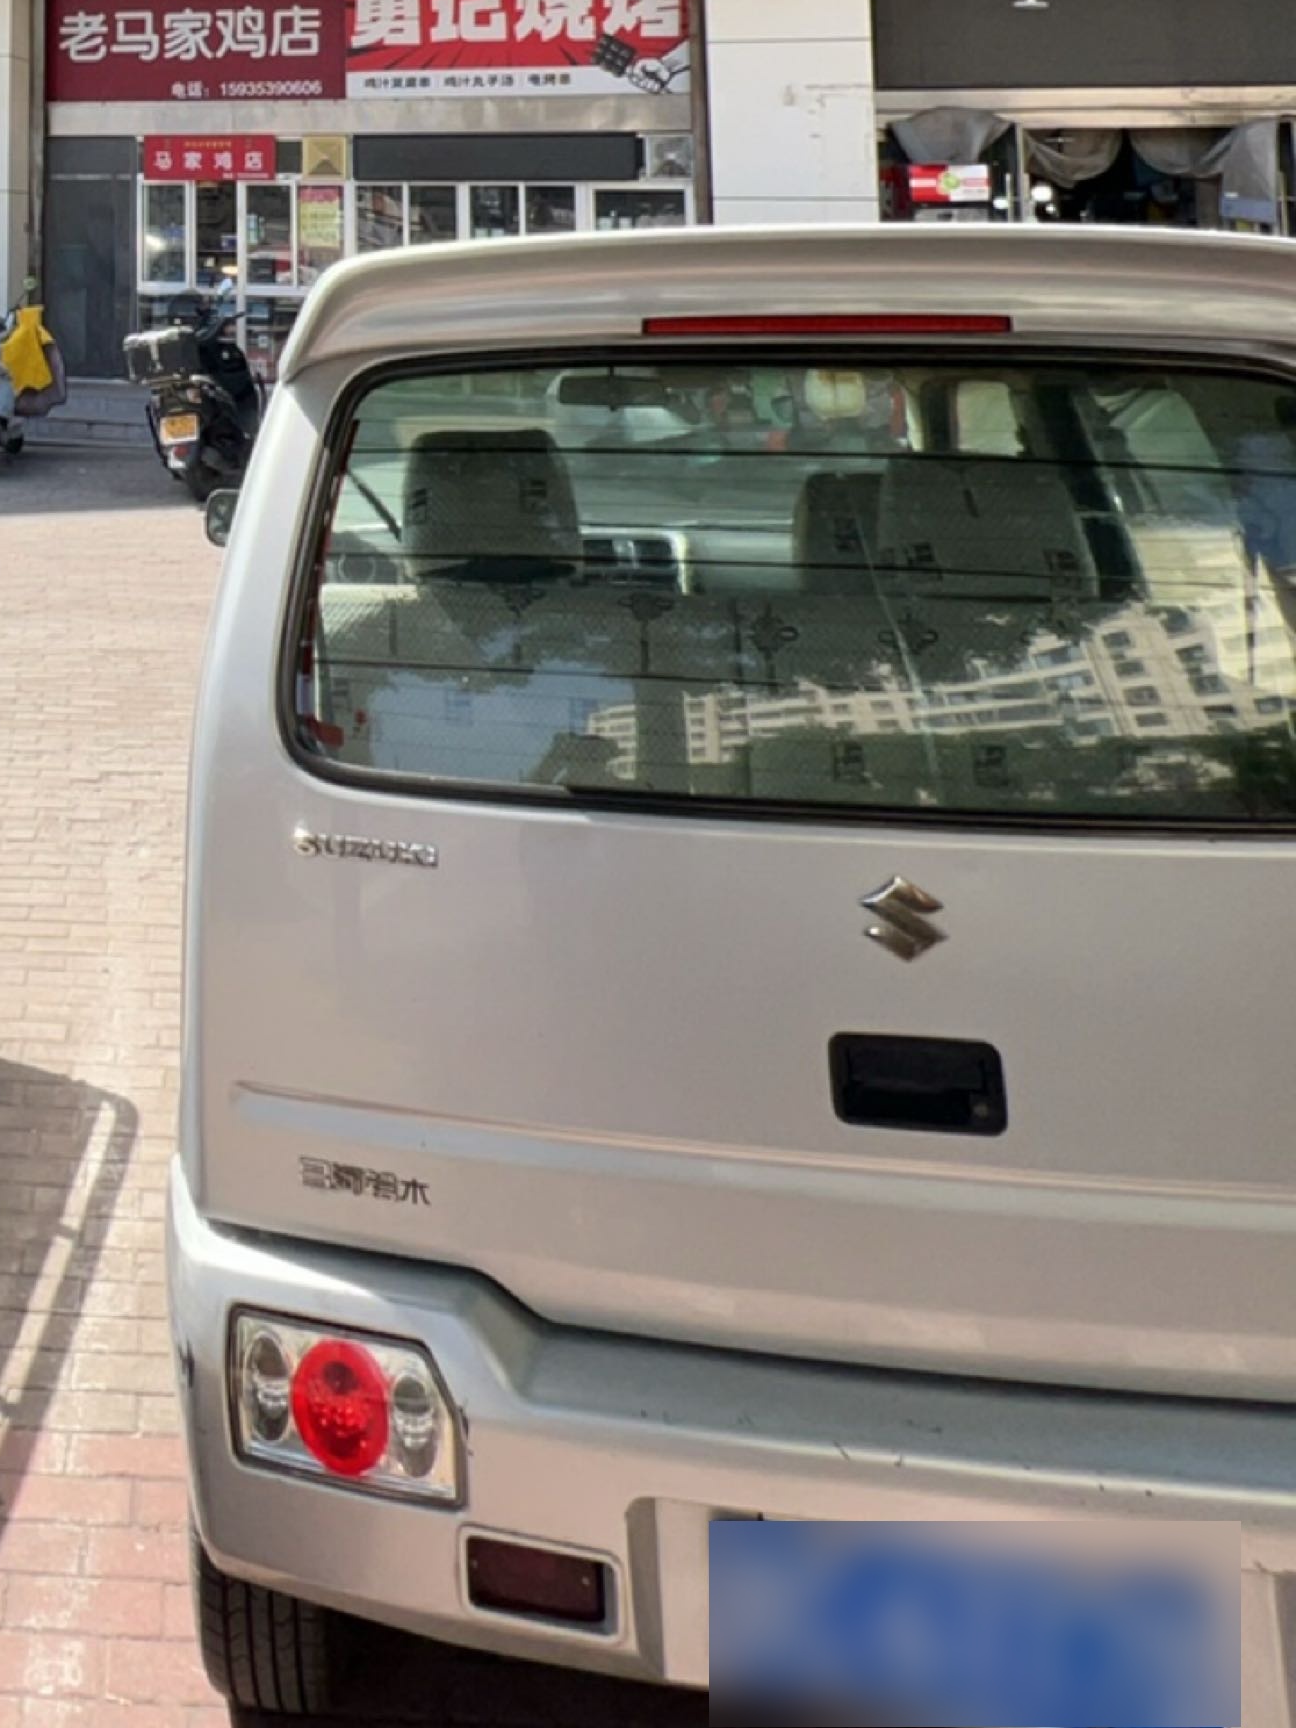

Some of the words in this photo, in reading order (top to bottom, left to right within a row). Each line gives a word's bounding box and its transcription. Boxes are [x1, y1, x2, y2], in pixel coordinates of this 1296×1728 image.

[59, 5, 322, 62] 老马家鸡店
